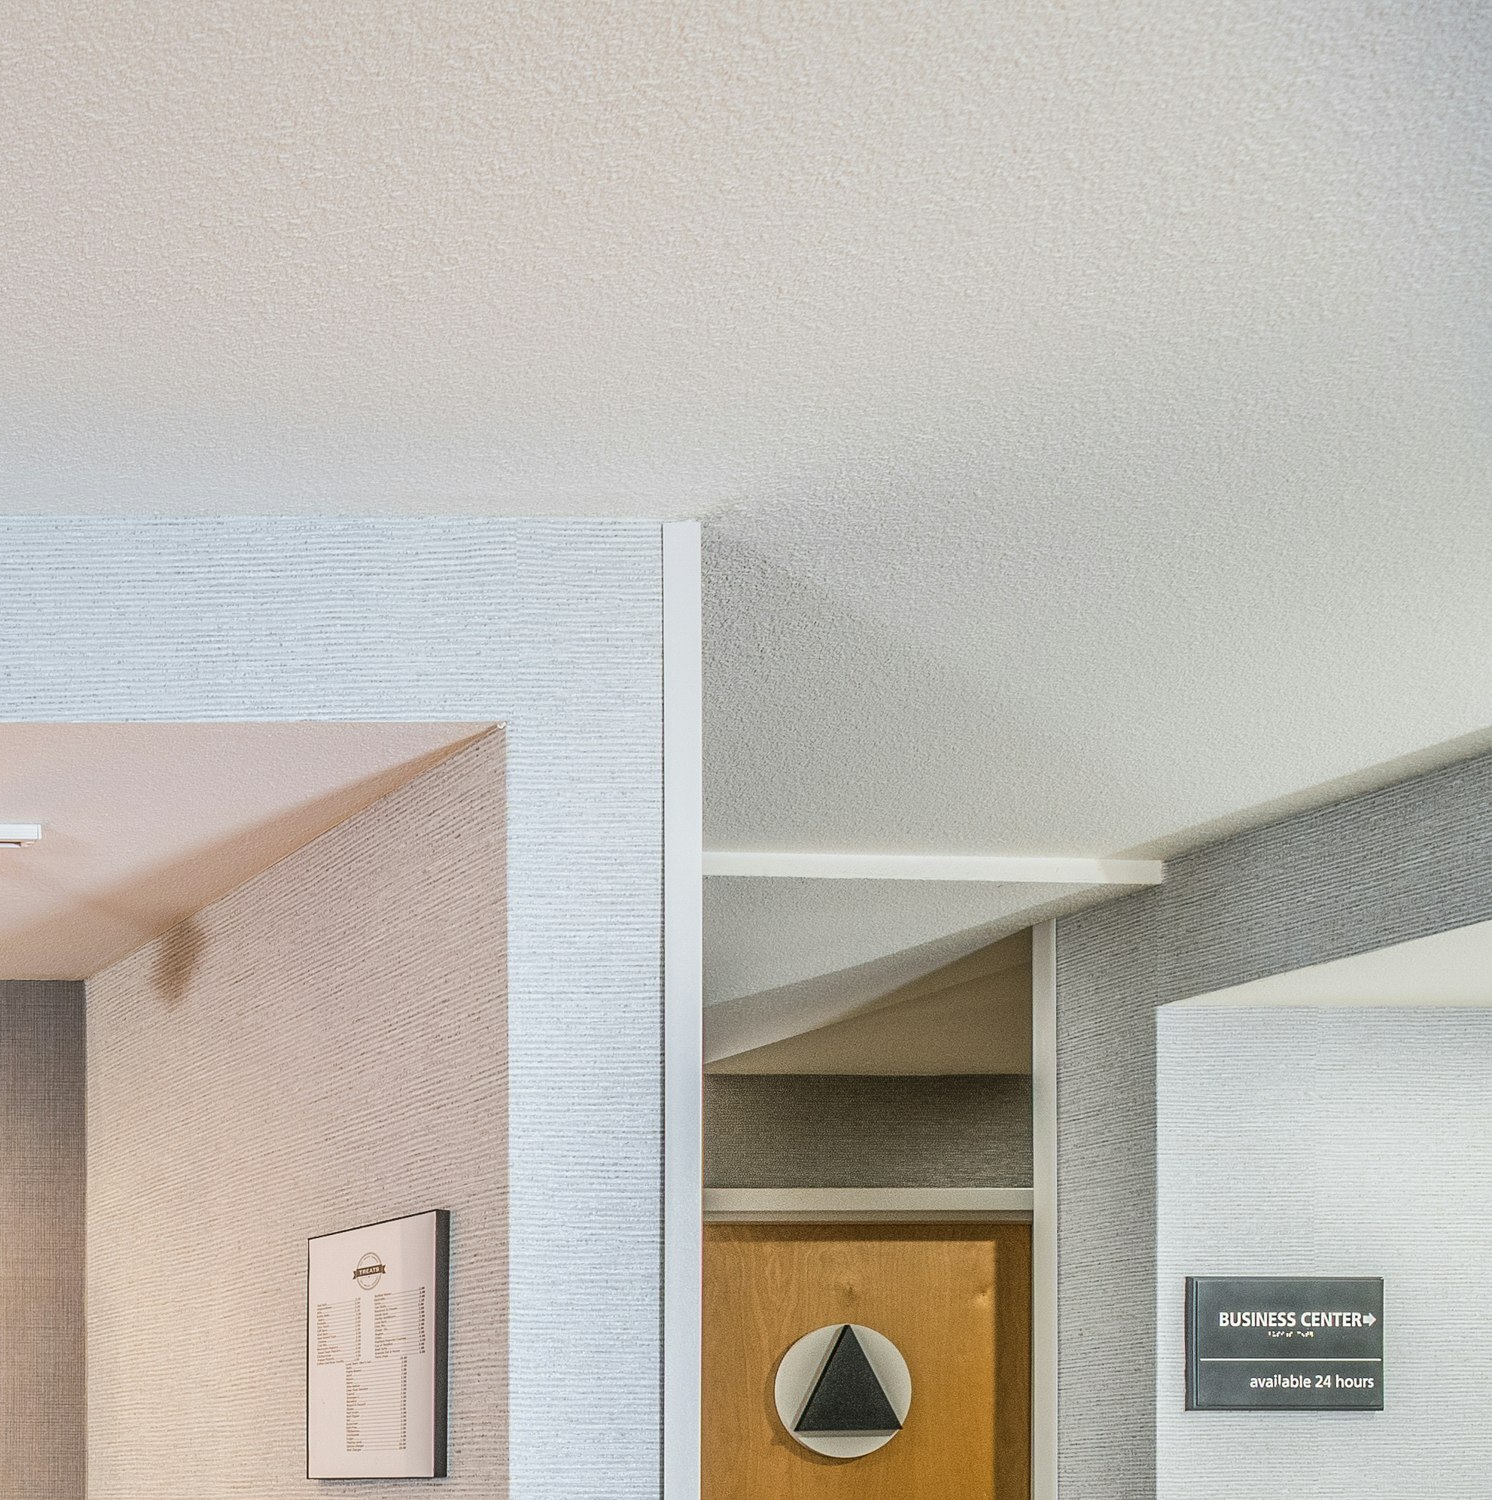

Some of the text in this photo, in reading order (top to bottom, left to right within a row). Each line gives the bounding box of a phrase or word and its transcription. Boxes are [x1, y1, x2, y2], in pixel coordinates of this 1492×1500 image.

[359, 1267, 380, 1276] TREATS
[1219, 1312, 1363, 1327] BUSINESS CENTER
[1250, 1374, 1374, 1389] available 24 hours
